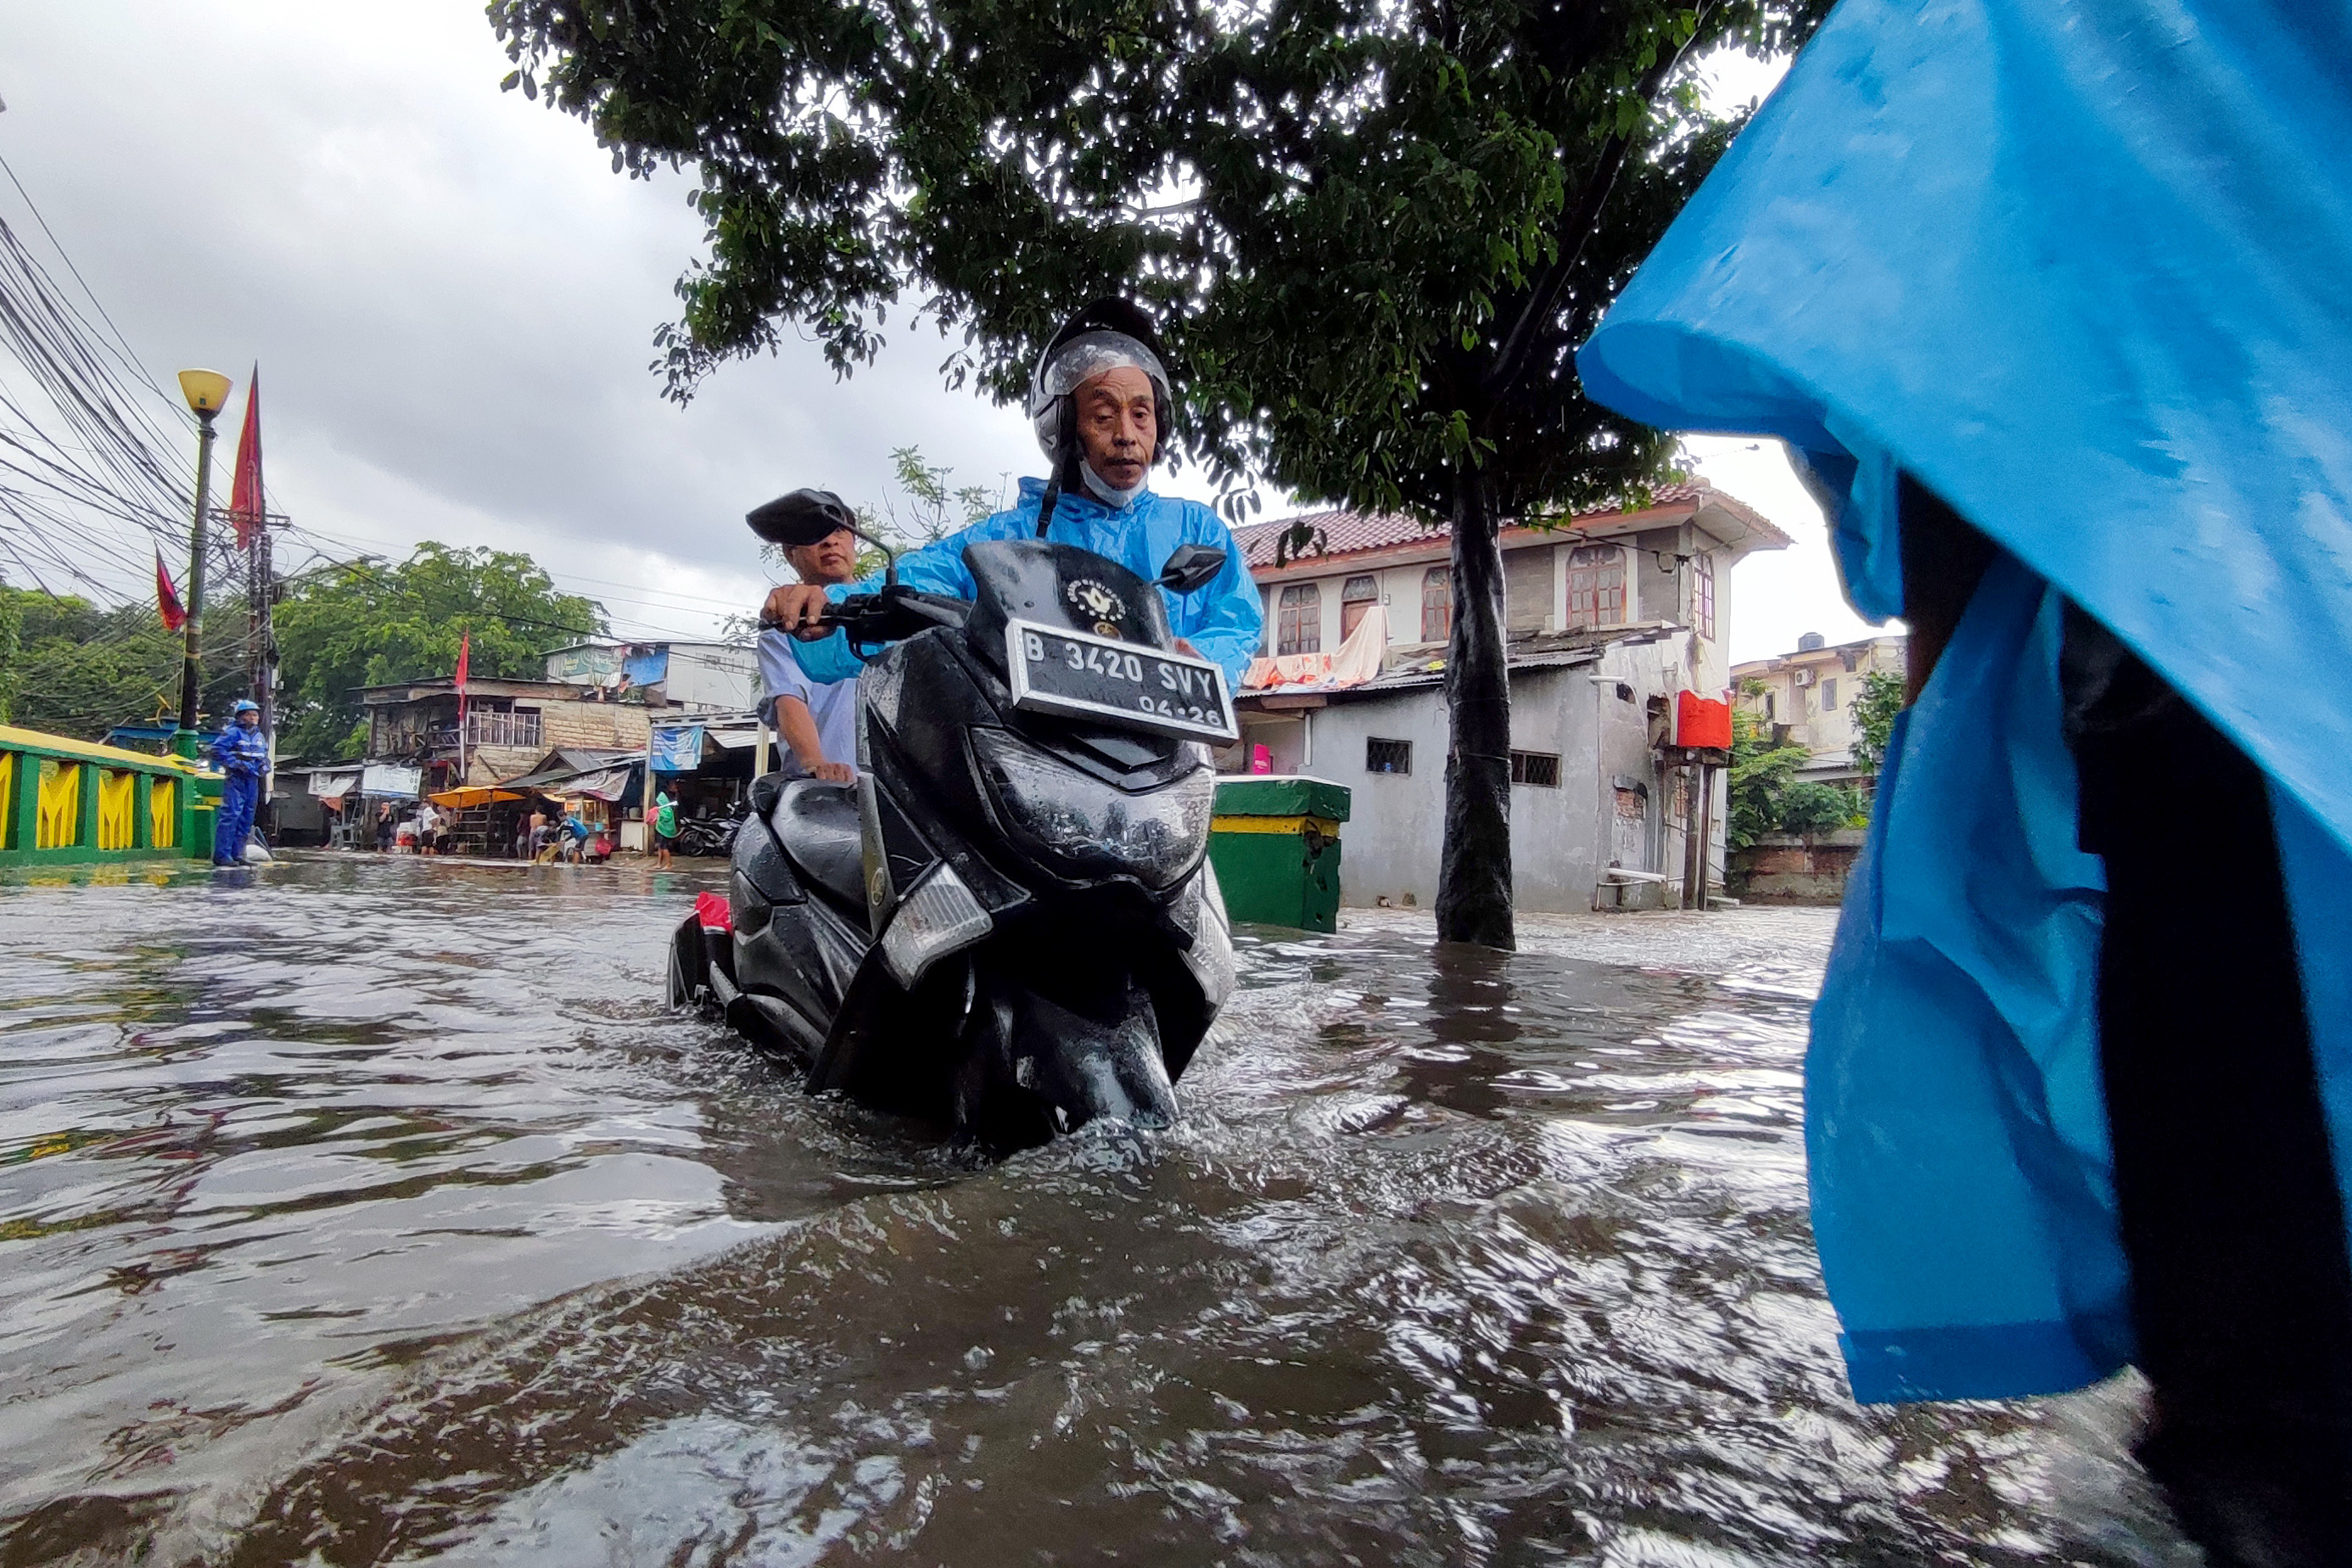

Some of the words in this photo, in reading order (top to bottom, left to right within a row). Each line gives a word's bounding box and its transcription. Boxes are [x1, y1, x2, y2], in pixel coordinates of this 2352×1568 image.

[1025, 633, 1044, 662] B
[1065, 642, 1143, 683] 3420
[1157, 663, 1211, 698] SVY
